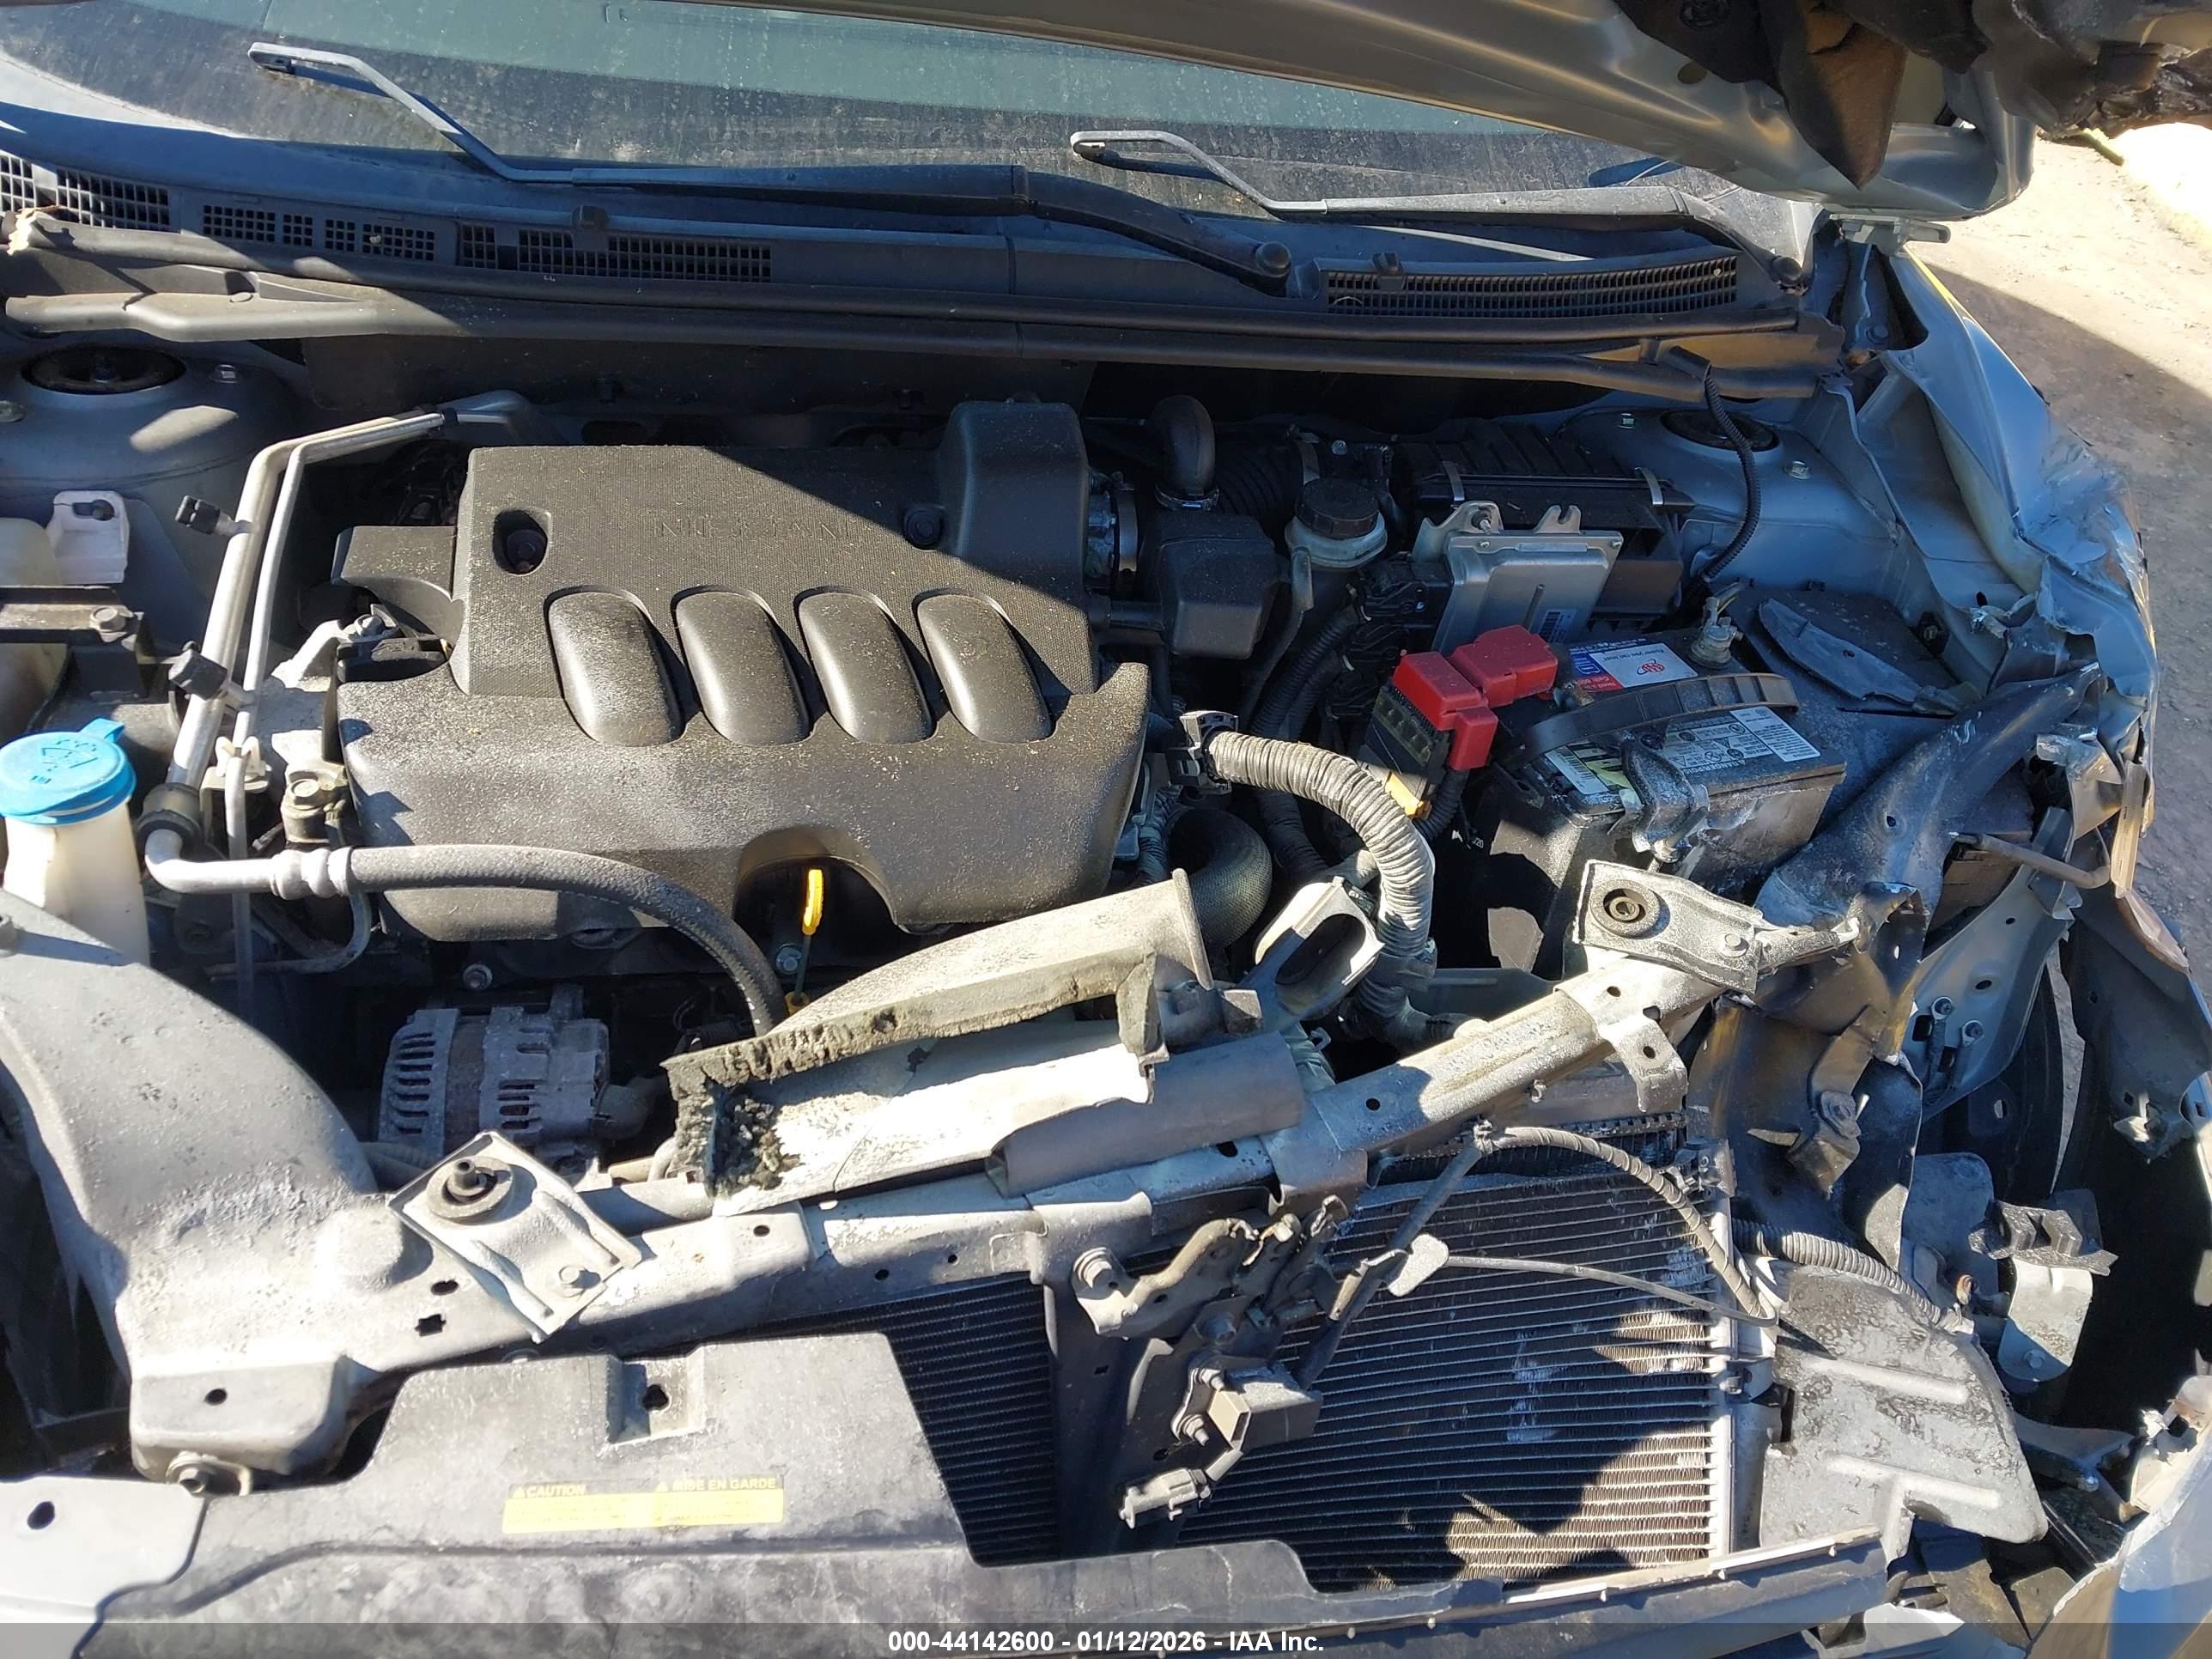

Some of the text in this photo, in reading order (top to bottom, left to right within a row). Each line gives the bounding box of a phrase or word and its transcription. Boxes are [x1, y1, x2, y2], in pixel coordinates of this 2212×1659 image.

[653, 516, 850, 538] NISSAN
[526, 1484, 586, 1498] CAUTION
[708, 1478, 727, 1491] EN
[730, 1477, 776, 1490] GARDE
